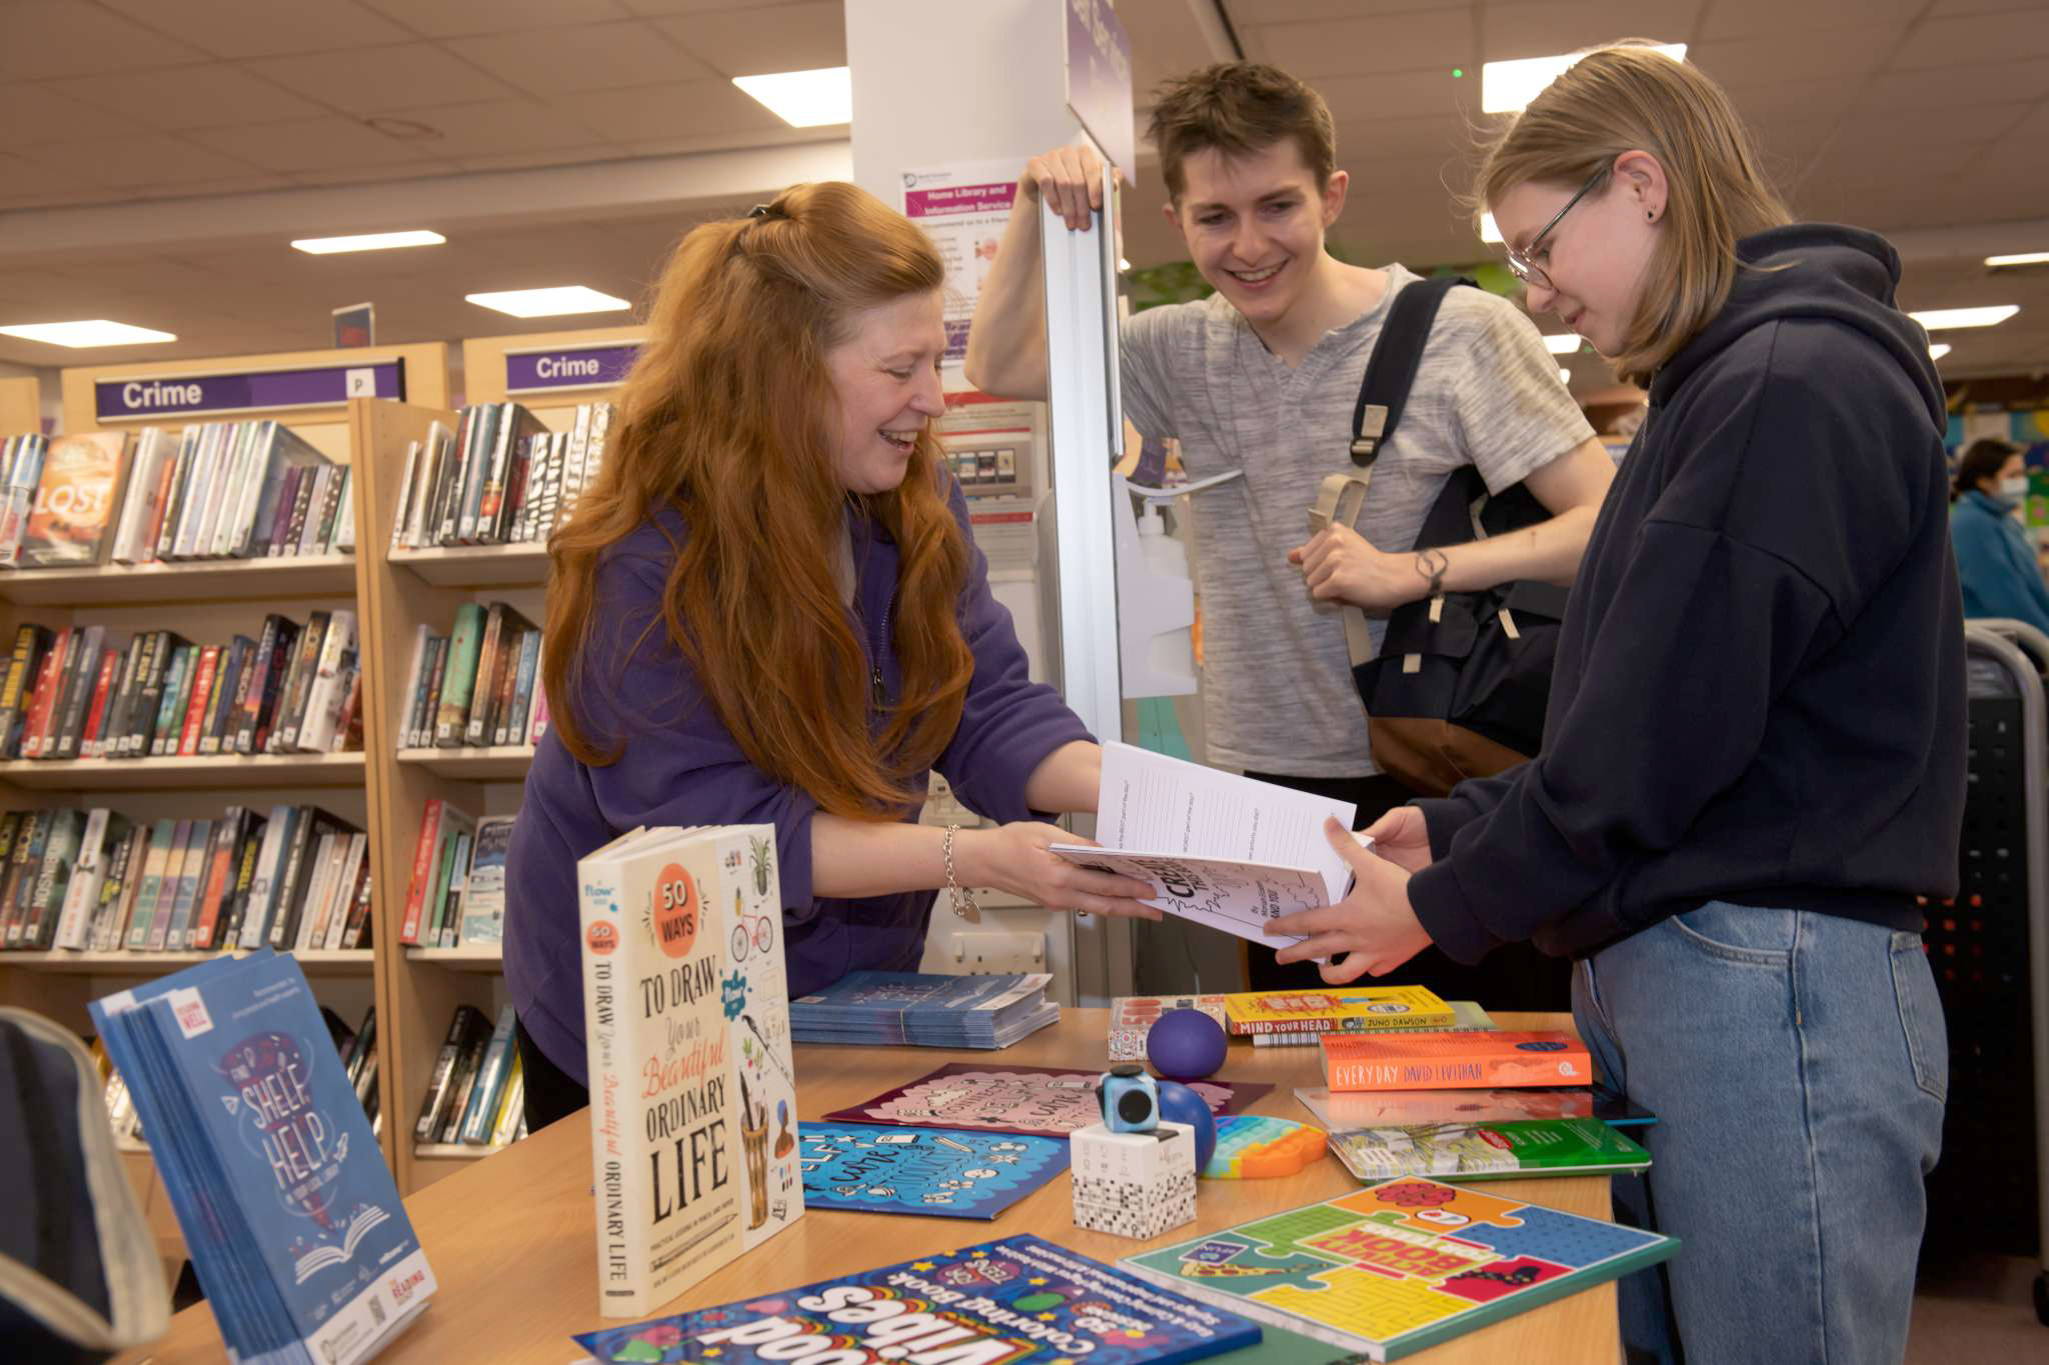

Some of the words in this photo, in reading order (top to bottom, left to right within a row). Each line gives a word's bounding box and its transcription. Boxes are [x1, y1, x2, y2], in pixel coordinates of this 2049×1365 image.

[924, 203, 976, 215] Information
[977, 200, 1011, 211] Service
[928, 190, 954, 201] Home
[955, 189, 987, 198] Library
[988, 185, 1007, 195] and
[354, 379, 363, 391] P
[536, 356, 600, 379] Crime
[123, 380, 203, 409] Crime
[662, 880, 689, 911] 50
[662, 914, 695, 943] WAYS
[595, 962, 613, 980] TO
[640, 974, 665, 1019] TO
[671, 954, 717, 1008] DRAW
[597, 984, 614, 1026] DRAW
[1368, 1018, 1390, 1027] JUNO
[1392, 1017, 1427, 1026] DAWSON
[1240, 1022, 1273, 1034] MIND
[1274, 1022, 1300, 1032] YOUR
[1300, 1020, 1330, 1031] HEAD
[642, 1024, 724, 1098] Beautiful
[1336, 1065, 1373, 1086] EVERY
[1375, 1066, 1399, 1084] DAY
[1404, 1065, 1432, 1081] DAVID
[242, 1063, 306, 1129] SHELF
[646, 1073, 727, 1143] ORDINARY
[262, 1111, 327, 1190] HELP
[829, 1150, 899, 1181] care
[650, 1118, 729, 1226] LIFE
[604, 1161, 624, 1244] ORDINARY
[608, 1243, 628, 1281] LIFE
[1313, 1240, 1435, 1277] ACTIVITY
[1332, 1229, 1474, 1269] BOOK
[887, 1271, 967, 1304] Book
[698, 1315, 869, 1365] ood
[797, 1286, 1017, 1365] Vibes
[955, 1295, 1096, 1354] Coloring
